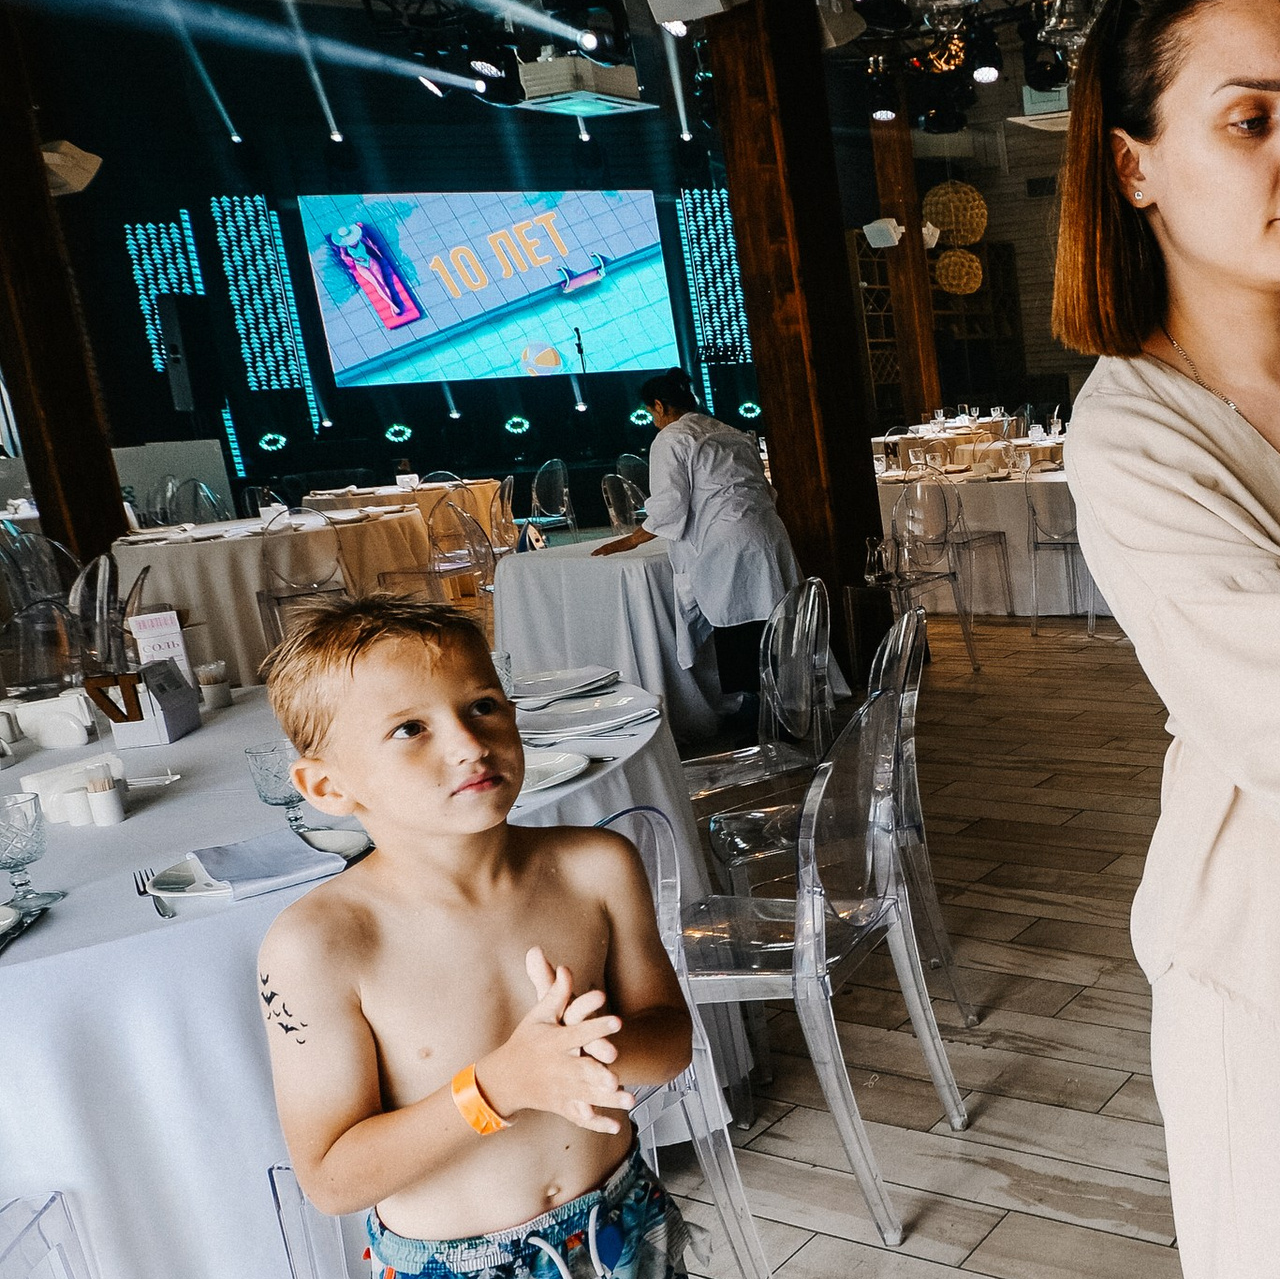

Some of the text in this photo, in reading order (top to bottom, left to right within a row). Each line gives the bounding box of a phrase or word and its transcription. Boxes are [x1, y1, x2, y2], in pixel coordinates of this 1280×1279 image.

[429, 212, 569, 299] 10 ЛЕТ
[142, 640, 180, 654] СОЛЬ
